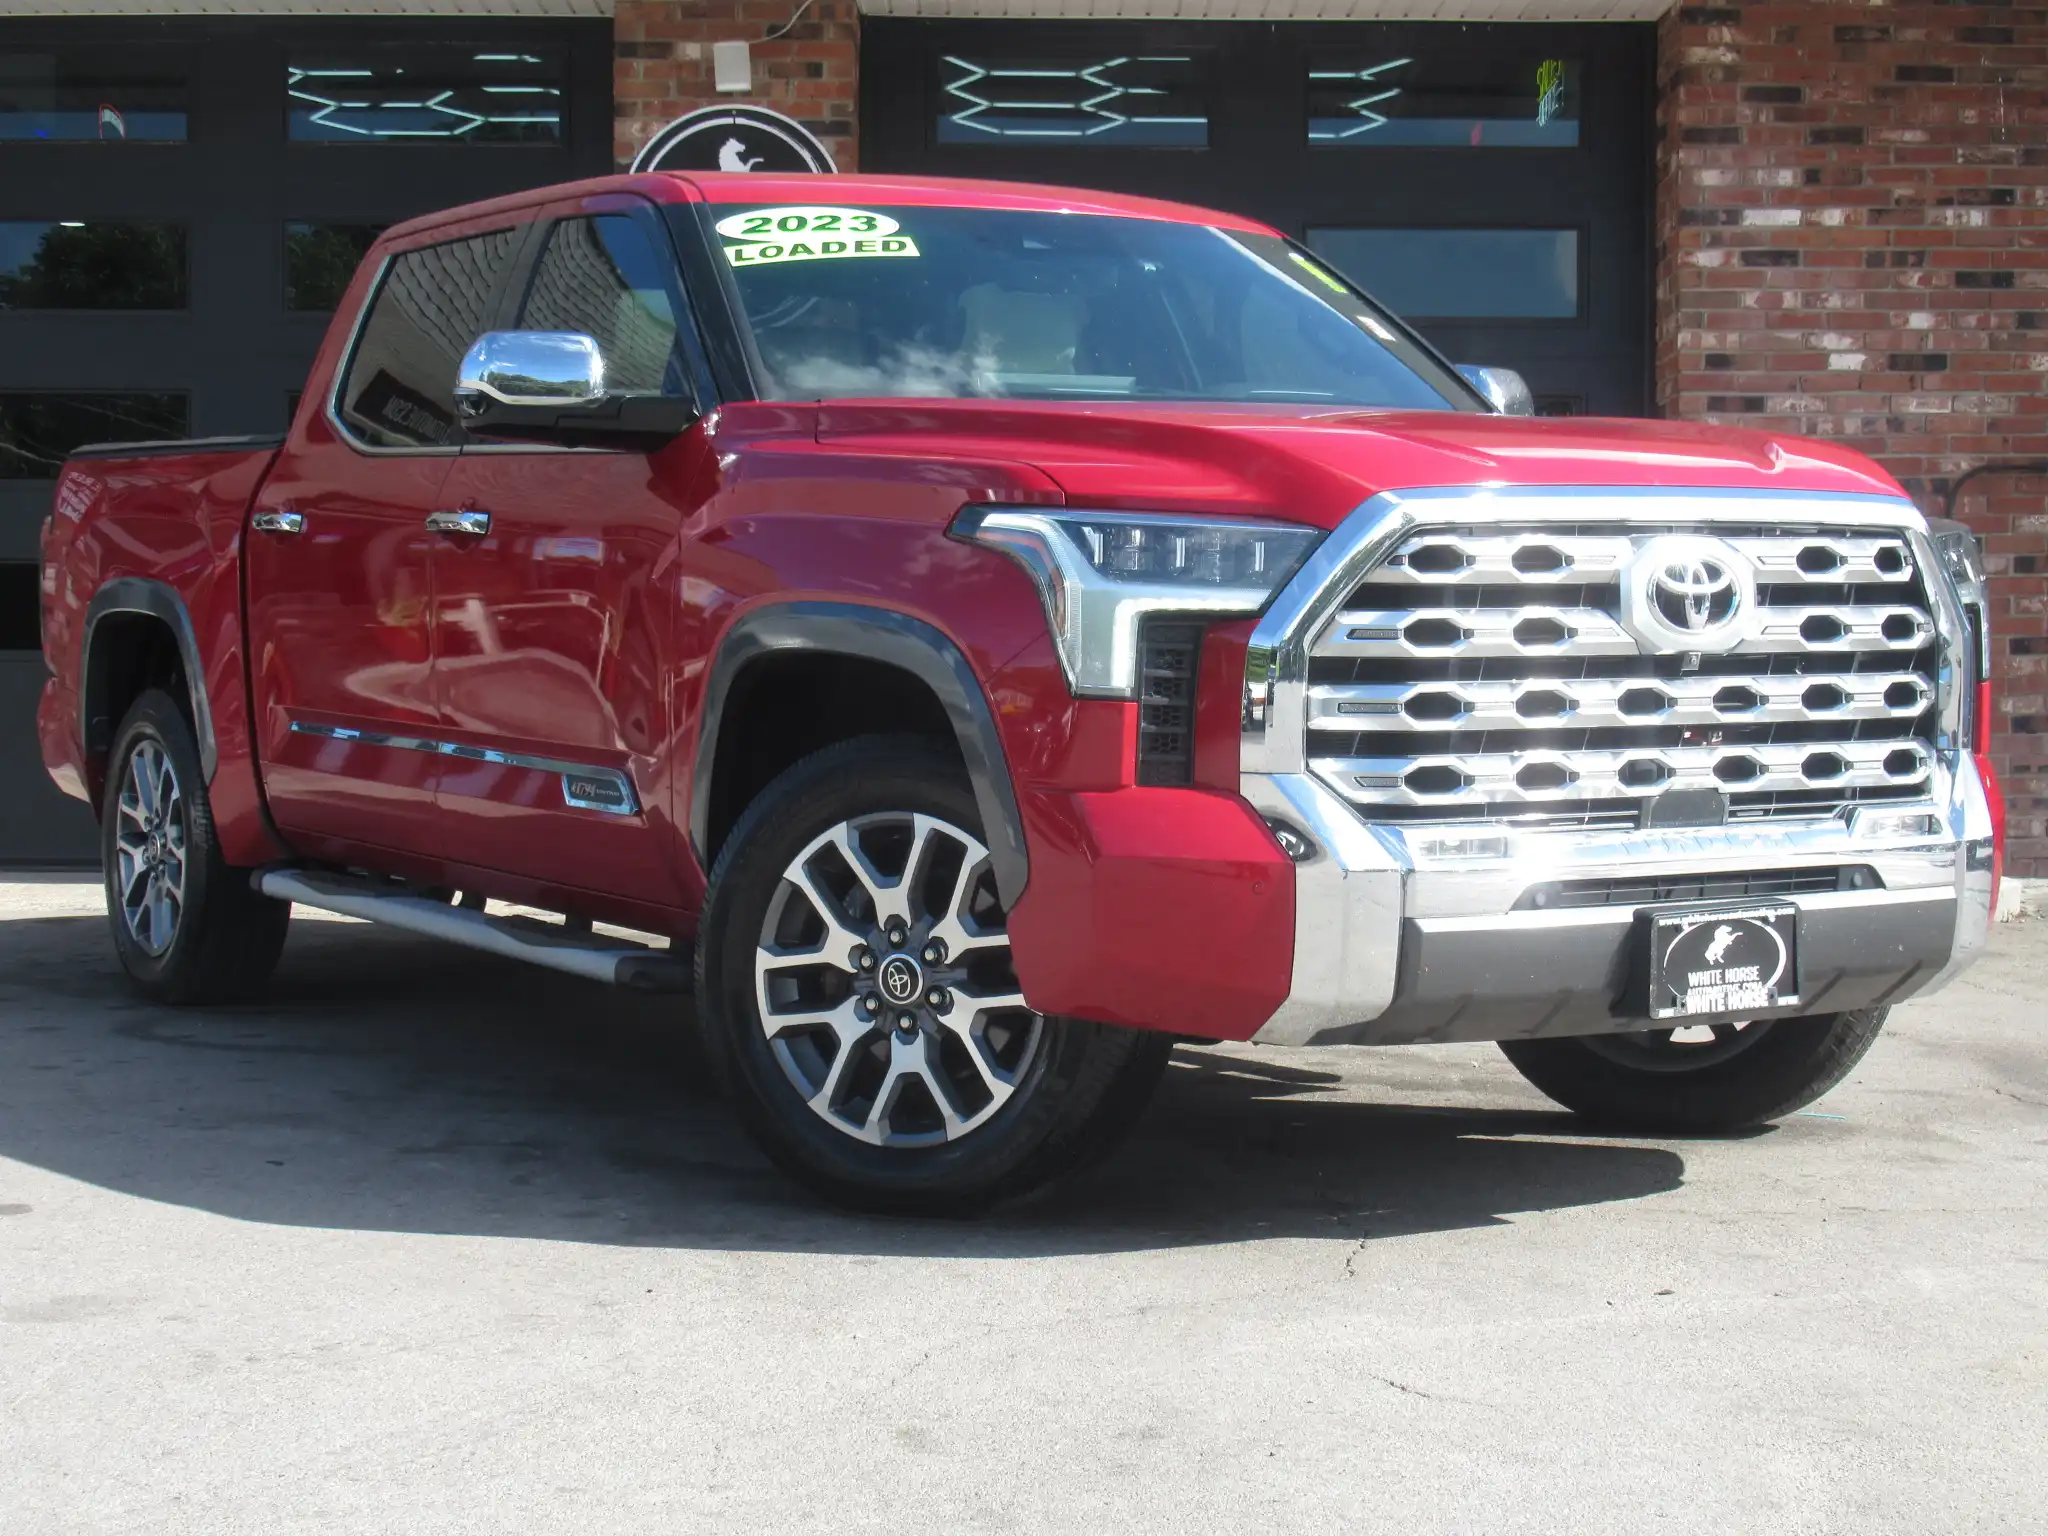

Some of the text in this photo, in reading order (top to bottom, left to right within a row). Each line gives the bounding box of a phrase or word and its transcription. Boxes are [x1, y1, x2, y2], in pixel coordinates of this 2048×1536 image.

[741, 215, 878, 234] 2023
[734, 240, 907, 262] LOADED
[1687, 966, 1761, 987] WHITE HORSE
[1686, 991, 1725, 1013] WHITE
[1728, 987, 1769, 1010] HORSE
